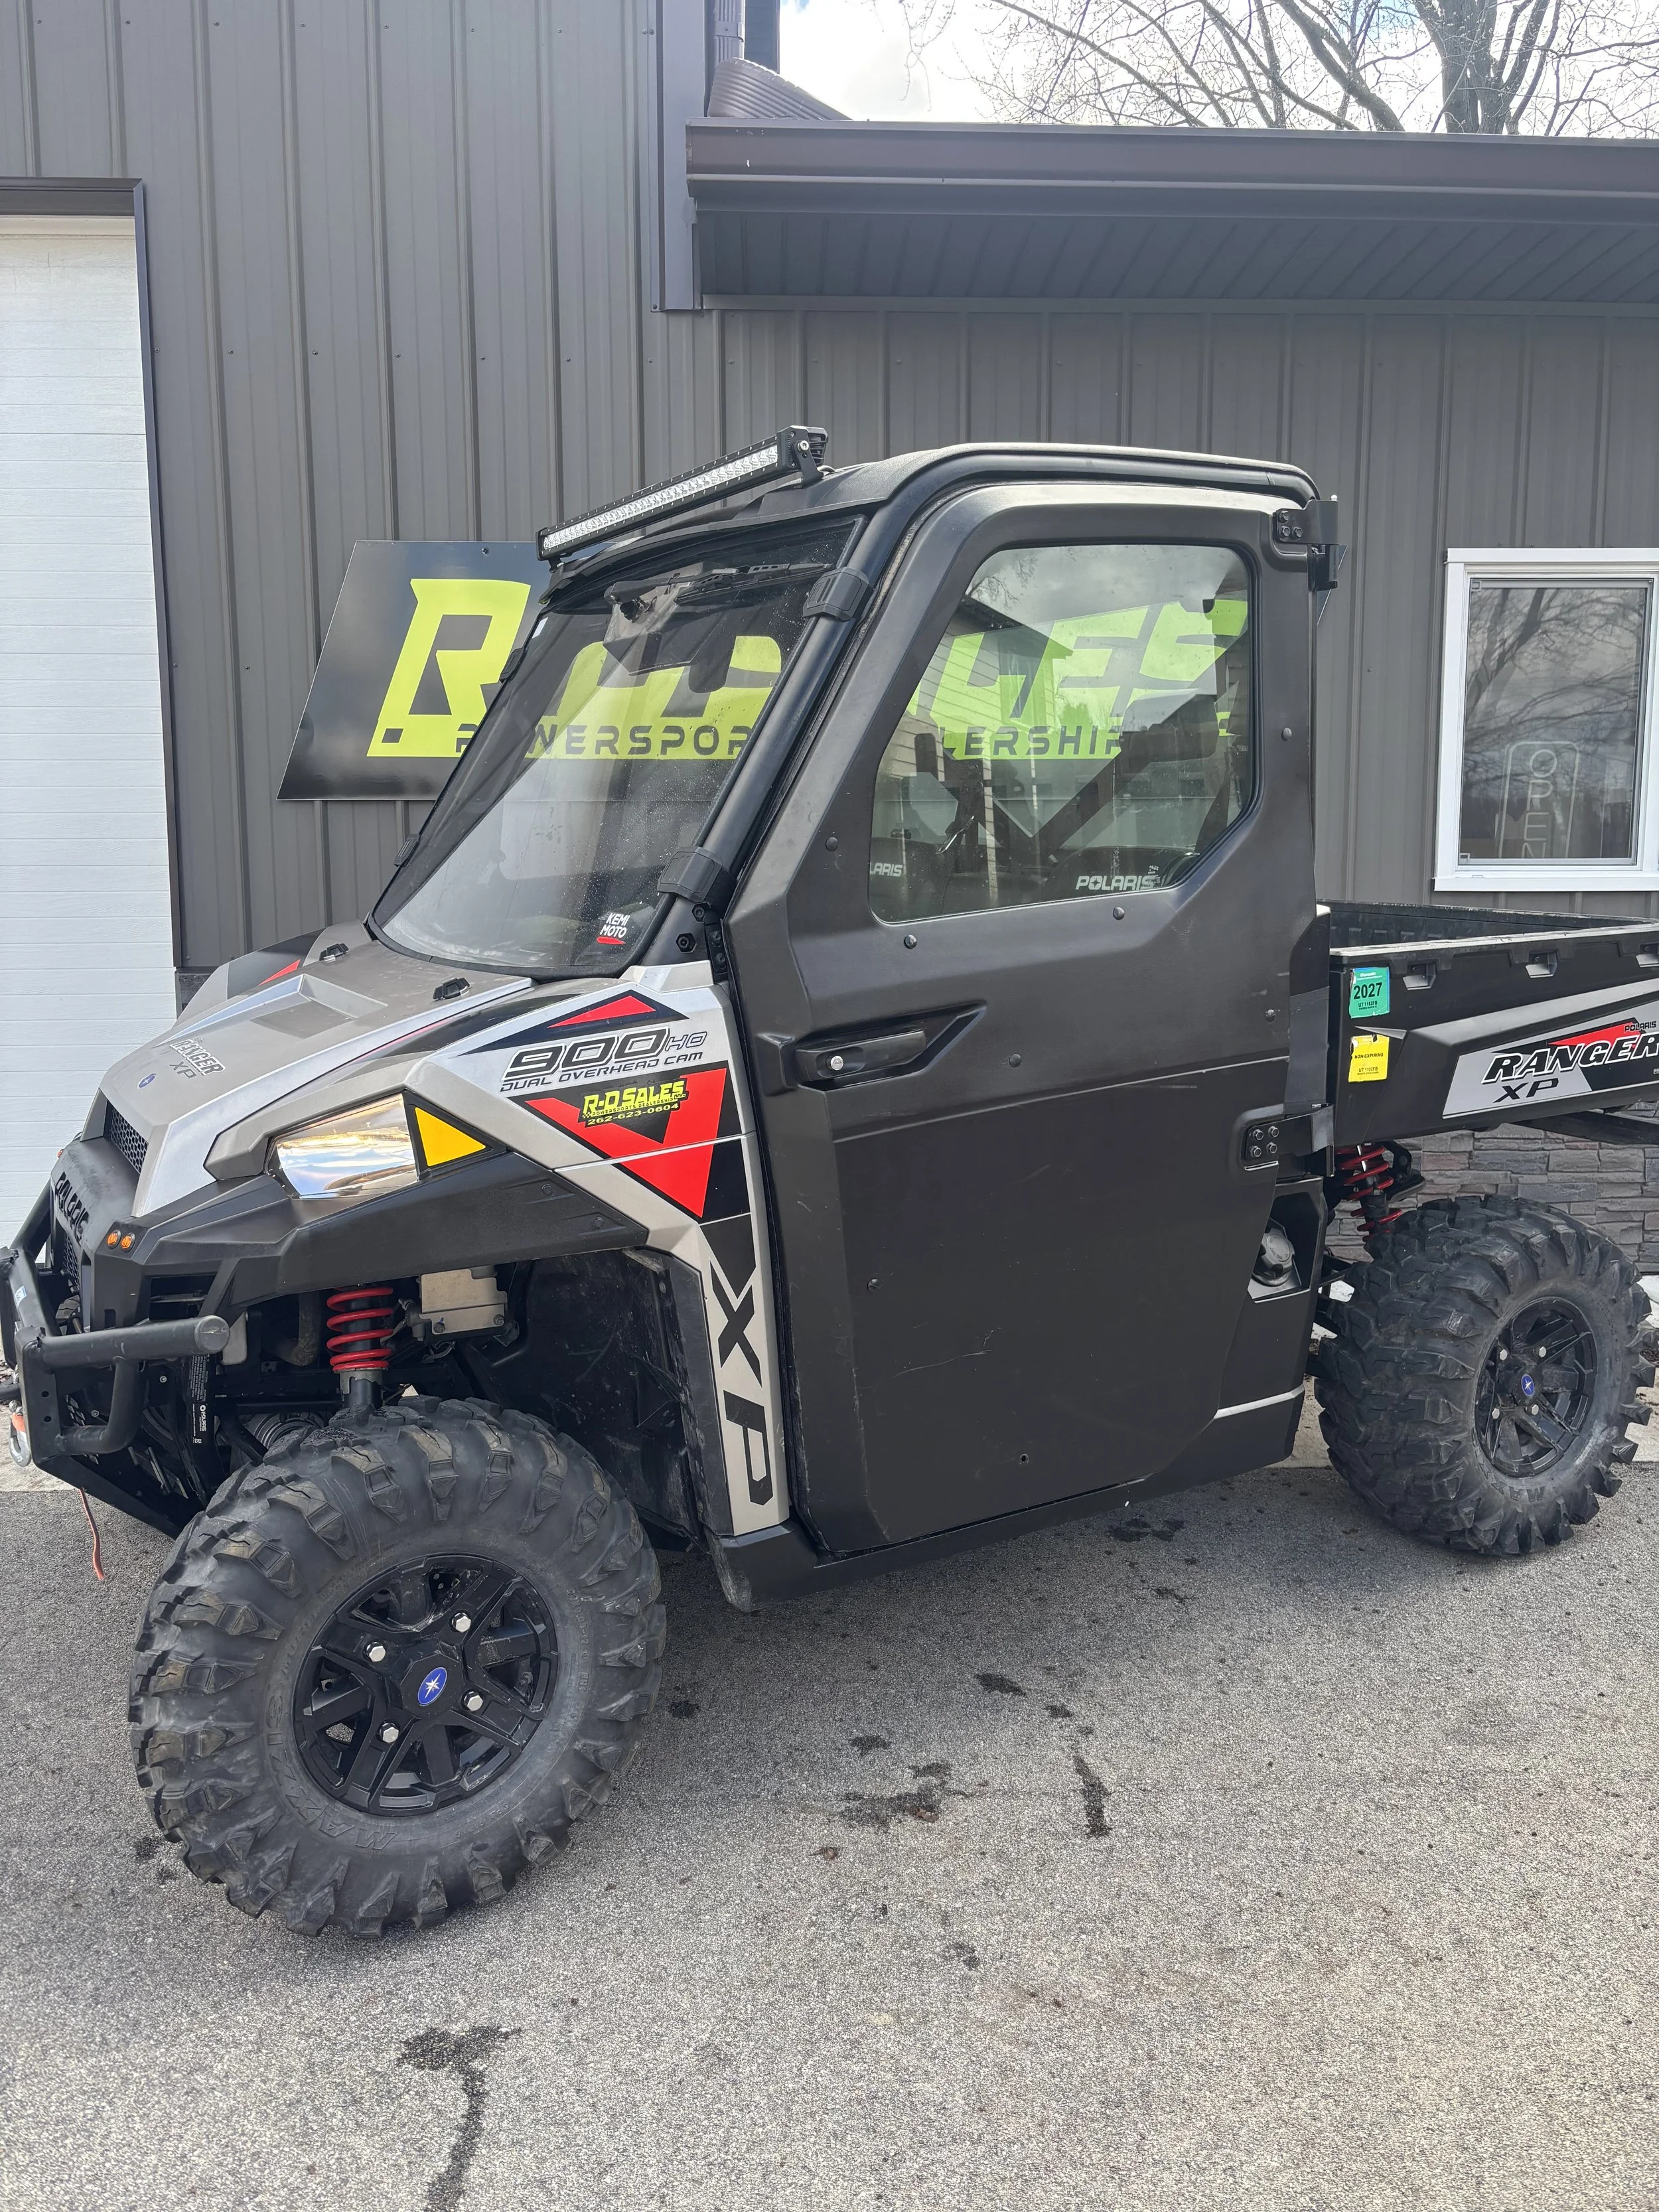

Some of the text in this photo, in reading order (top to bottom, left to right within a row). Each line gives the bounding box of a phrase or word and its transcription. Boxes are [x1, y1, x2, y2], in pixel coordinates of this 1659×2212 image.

[1521, 749, 1558, 859] OPEN
[869, 861, 903, 877] LARIS
[1075, 875, 1156, 891] POLARIS
[599, 924, 627, 938] MOTO
[605, 913, 630, 926] KEMI
[1353, 982, 1383, 999] 2027
[1624, 1021, 1658, 1033] POLARIS
[169, 1039, 226, 1076] RANGER
[501, 1025, 670, 1083] 900
[1480, 1032, 1659, 1085] RANGER
[169, 1061, 197, 1078] XP
[499, 1051, 703, 1092] DUAL OVERHEAD CAM
[583, 1080, 685, 1115] R-D SALES
[1492, 1077, 1559, 1104] XP
[587, 1102, 680, 1126] 262-623-0604
[592, 1104, 636, 1116] POWERSPORTS
[638, 1097, 674, 1108] DEALERSHIP
[709, 1260, 774, 1506] XP
[267, 1694, 397, 1851] MAXXIS
